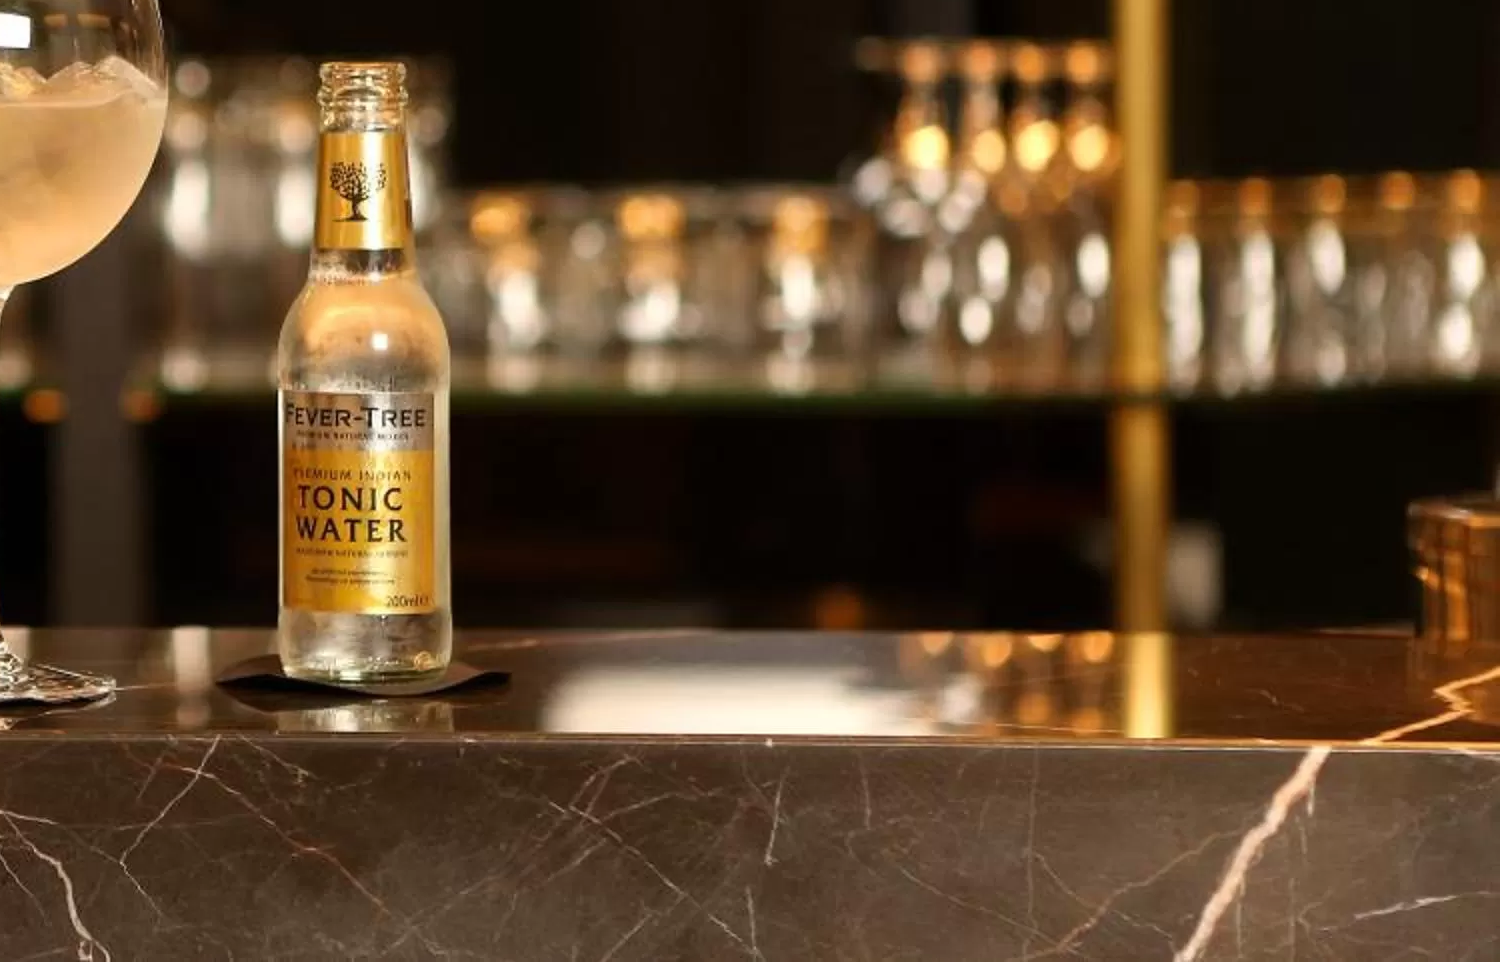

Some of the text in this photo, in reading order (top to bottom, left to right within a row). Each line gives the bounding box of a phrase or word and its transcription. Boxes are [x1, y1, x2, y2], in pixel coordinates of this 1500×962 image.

[285, 401, 426, 428] FEVER-TREE
[297, 484, 403, 511] TONIC
[295, 515, 407, 543] WATER
